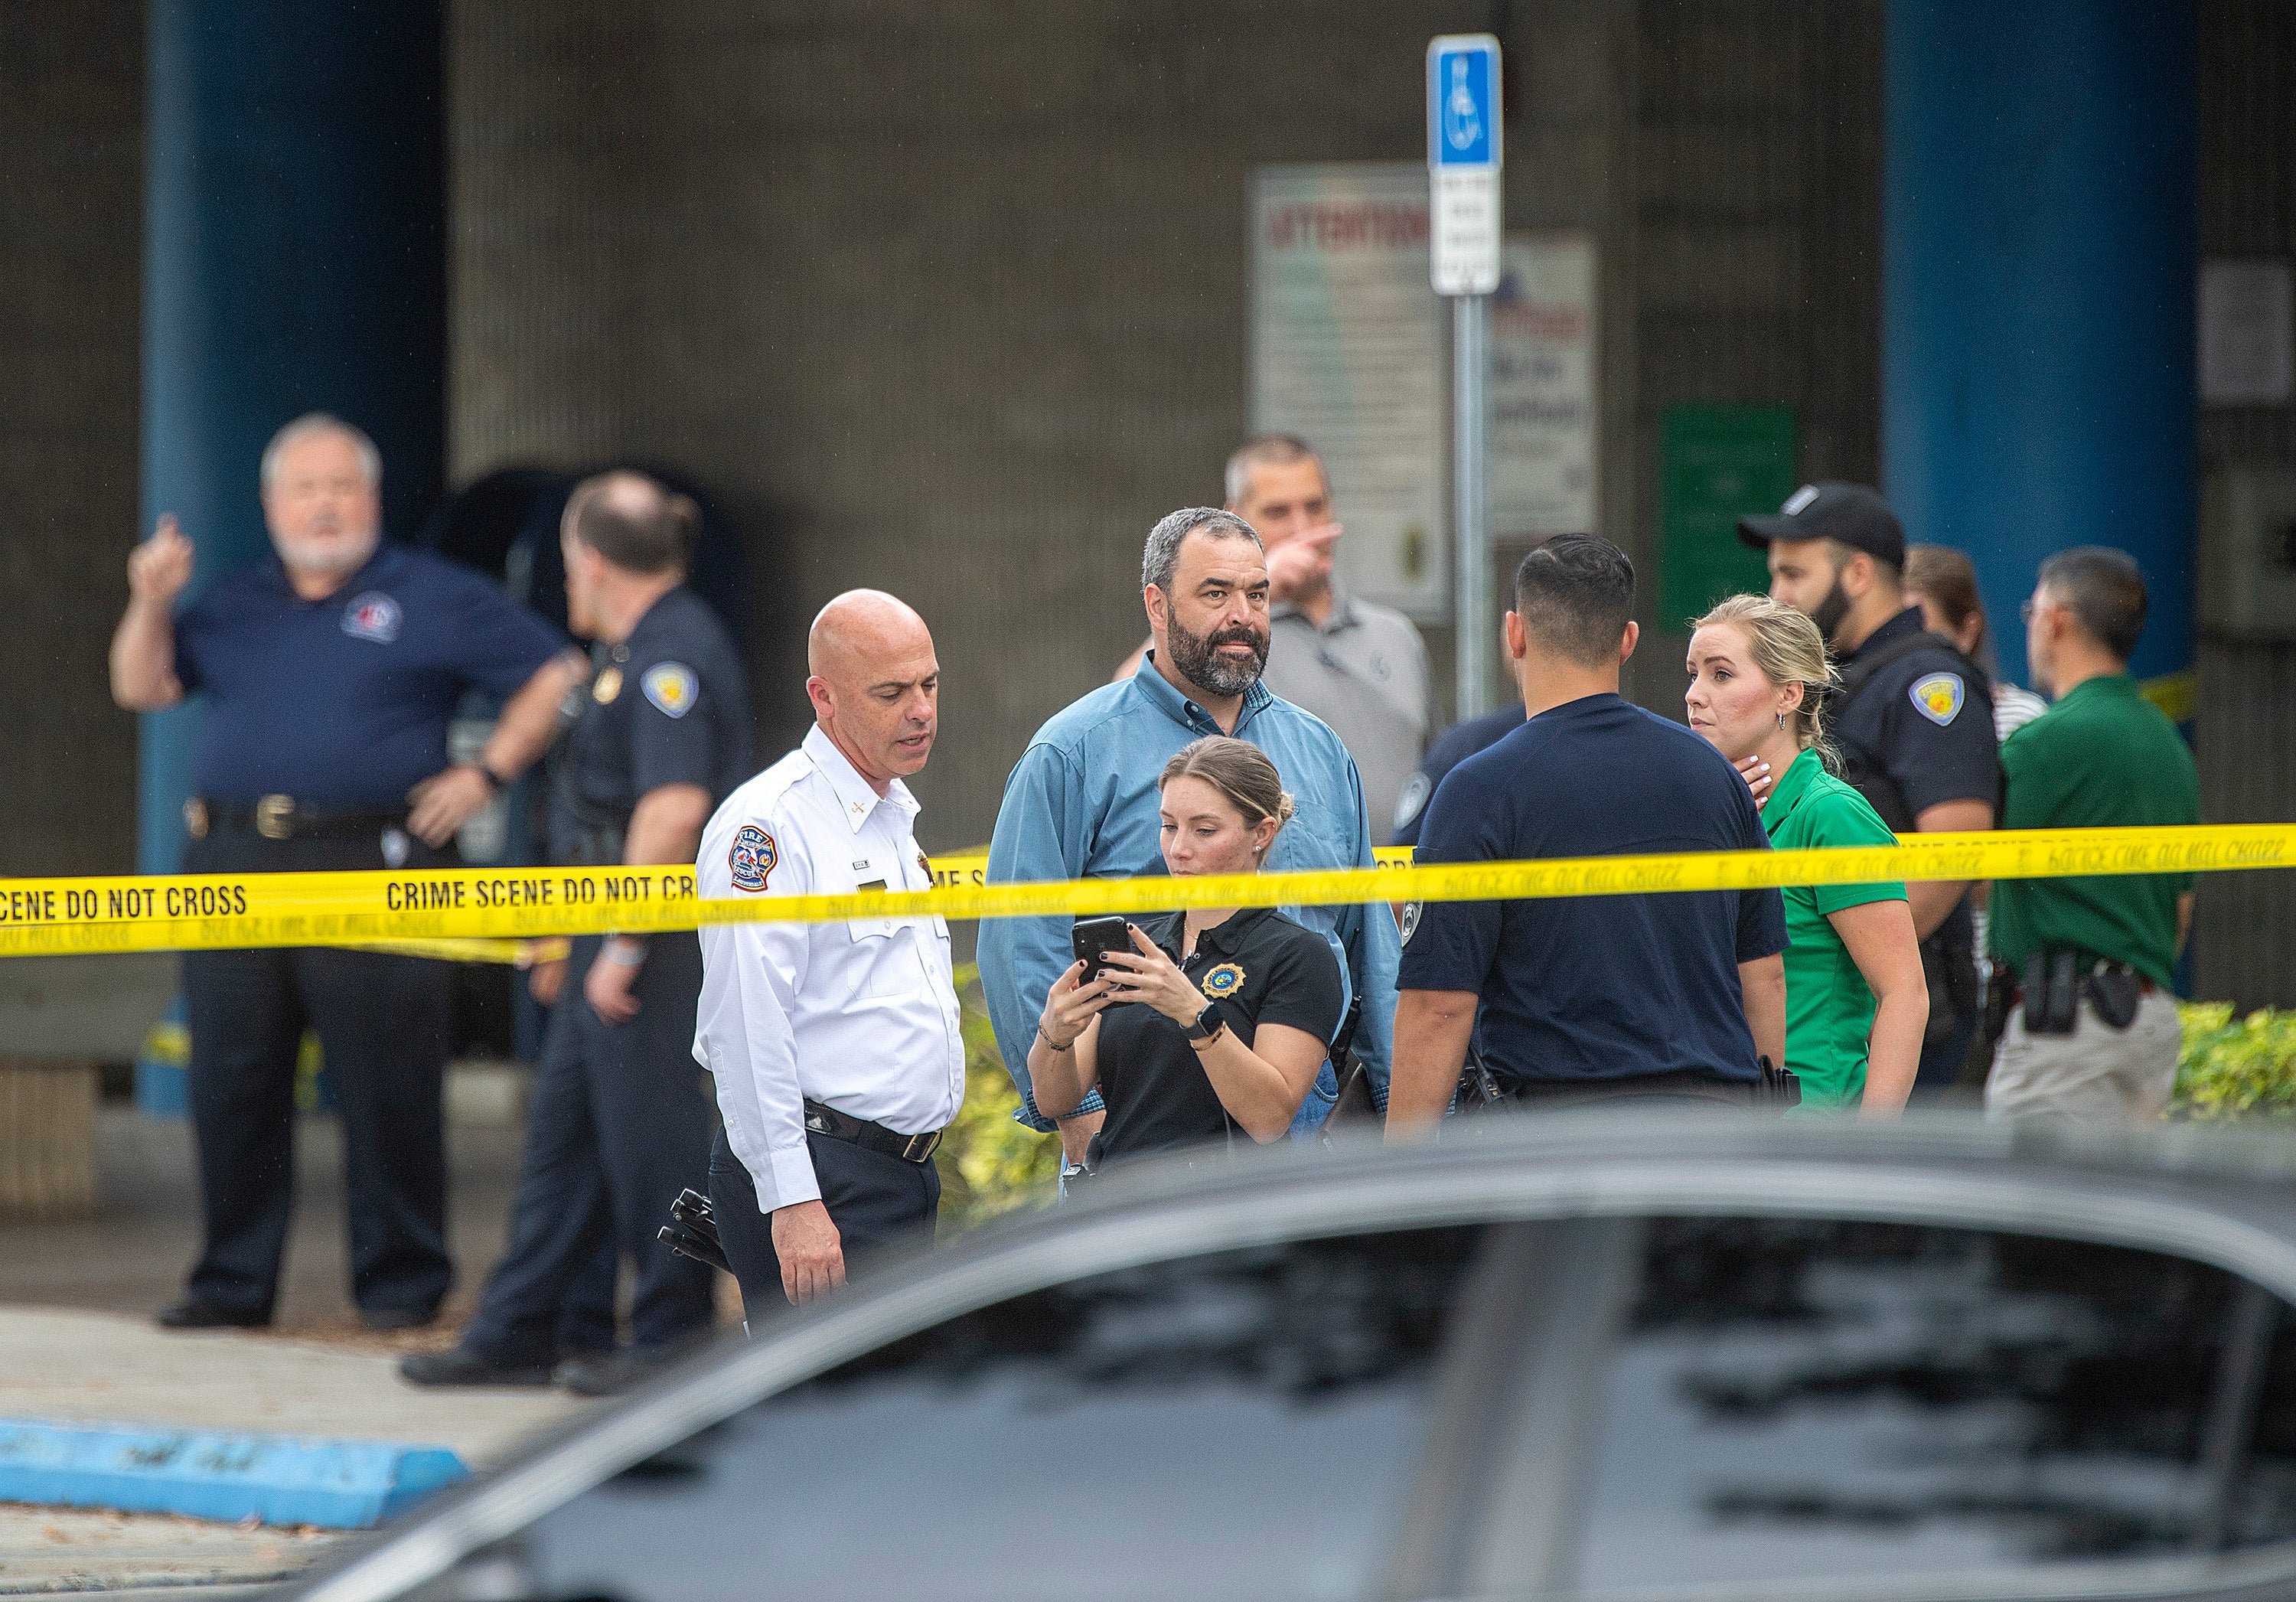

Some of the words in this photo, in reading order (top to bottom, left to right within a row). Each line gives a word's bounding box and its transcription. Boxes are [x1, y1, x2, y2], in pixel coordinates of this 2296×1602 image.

[739, 831, 763, 843] FIRE
[67, 889, 97, 918] DO
[109, 888, 155, 918] NOT
[167, 886, 246, 917] CROSS
[387, 881, 465, 911] CRIME
[476, 879, 553, 909] SCENE
[563, 877, 595, 905] DO
[605, 876, 651, 903] NOT
